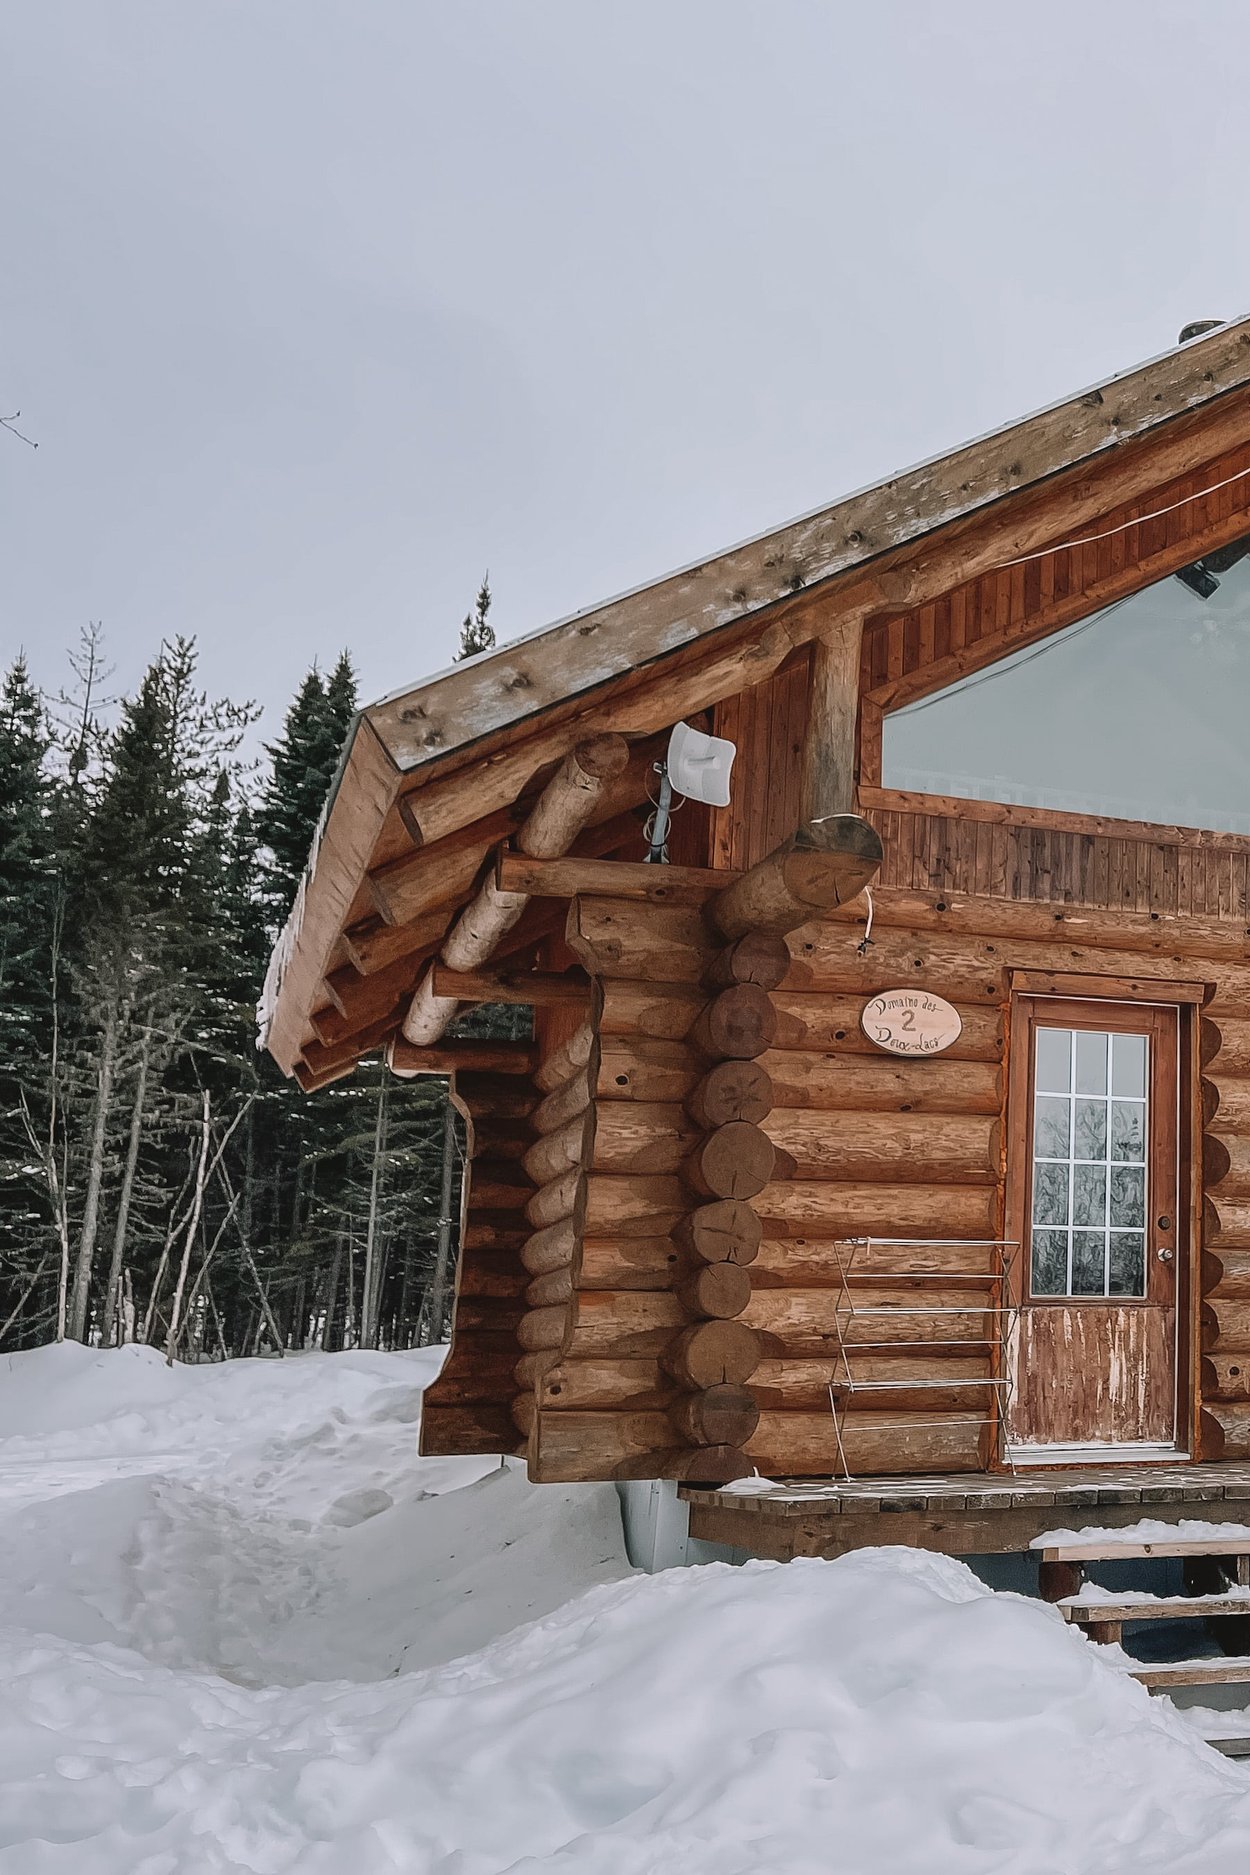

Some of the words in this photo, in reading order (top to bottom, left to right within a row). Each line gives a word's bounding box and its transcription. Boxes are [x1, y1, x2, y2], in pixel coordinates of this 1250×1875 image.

[868, 996, 918, 1015] Domaine
[922, 995, 943, 1012] des
[901, 1009, 917, 1031] 2
